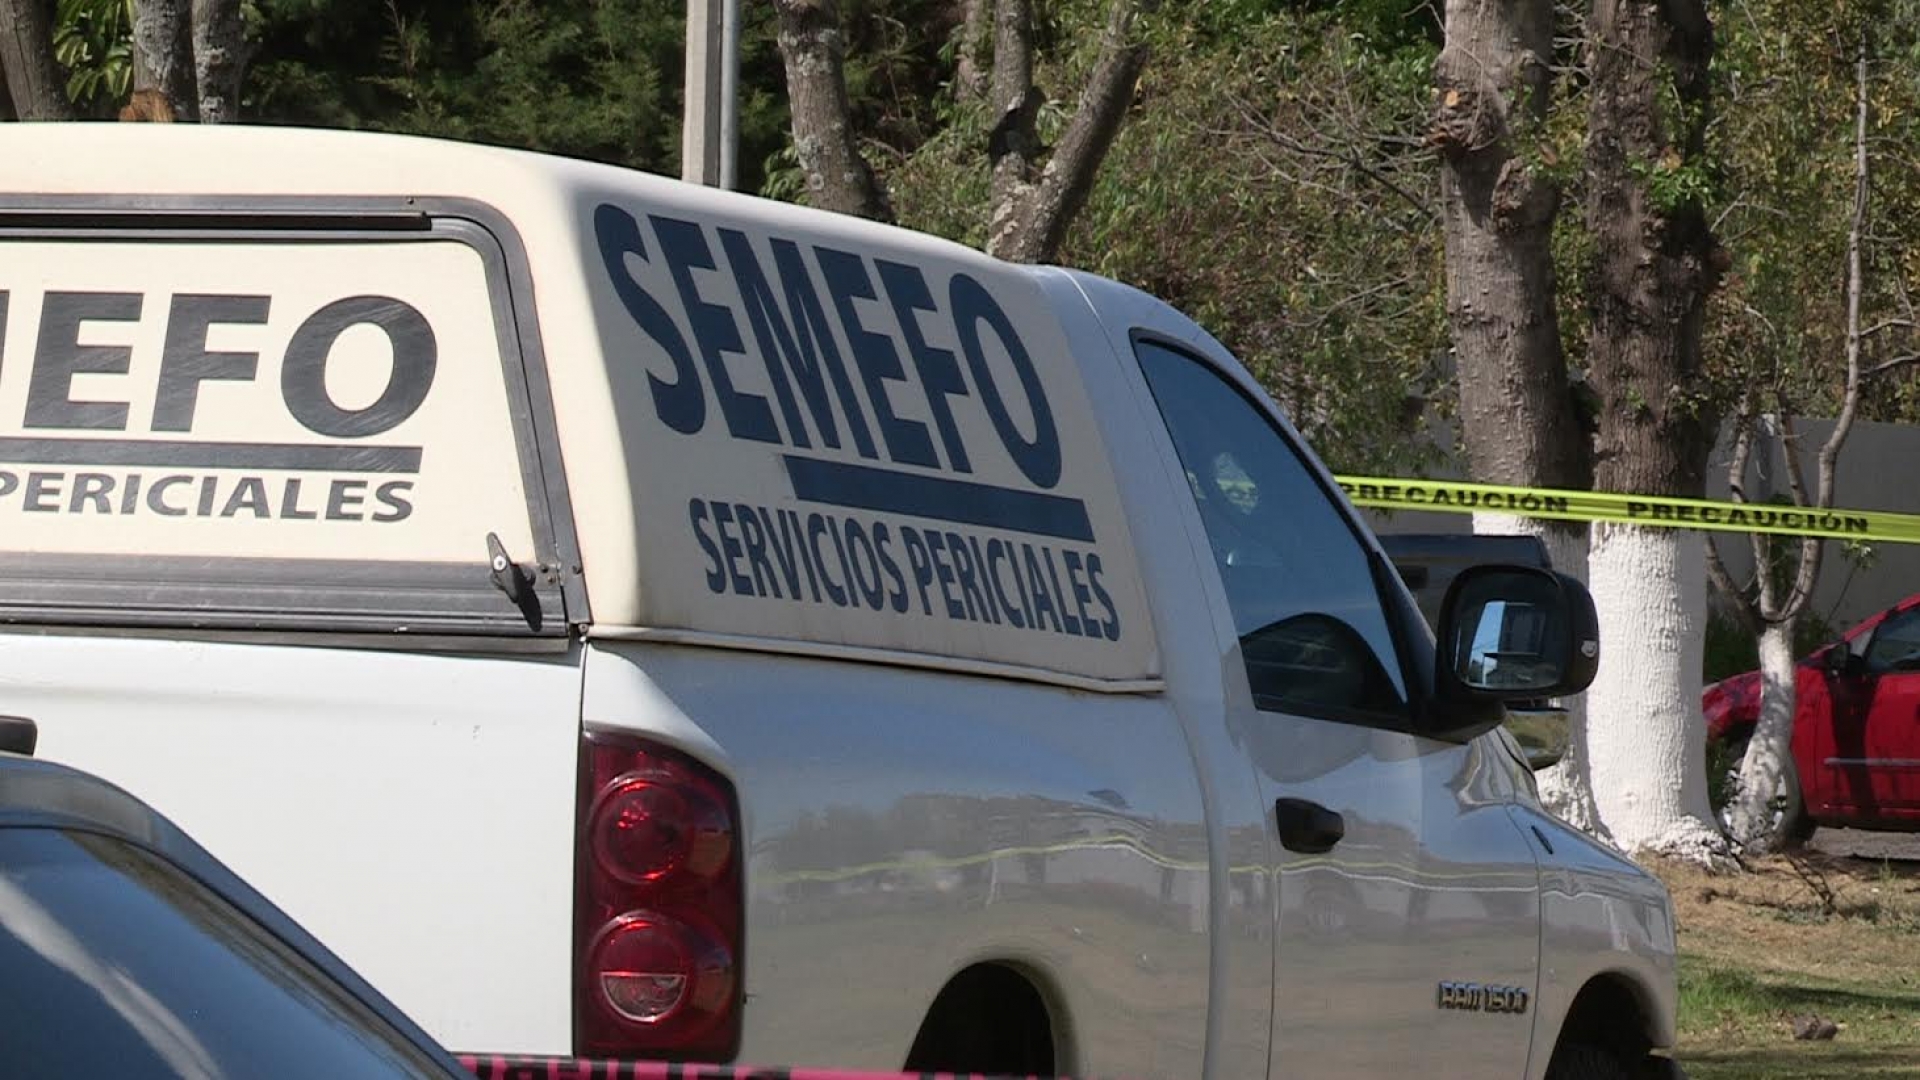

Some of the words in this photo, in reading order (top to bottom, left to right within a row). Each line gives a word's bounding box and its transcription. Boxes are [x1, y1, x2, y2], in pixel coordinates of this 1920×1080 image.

[0, 289, 438, 439] EFO
[594, 203, 1062, 489] SEMEFO
[689, 498, 908, 613] SERVICIOS
[900, 526, 1121, 642] PERICIALES
[1627, 501, 1868, 532] PRECAUCIÓN
[1439, 980, 1481, 1010] RAM
[1485, 984, 1529, 1013] 1500
